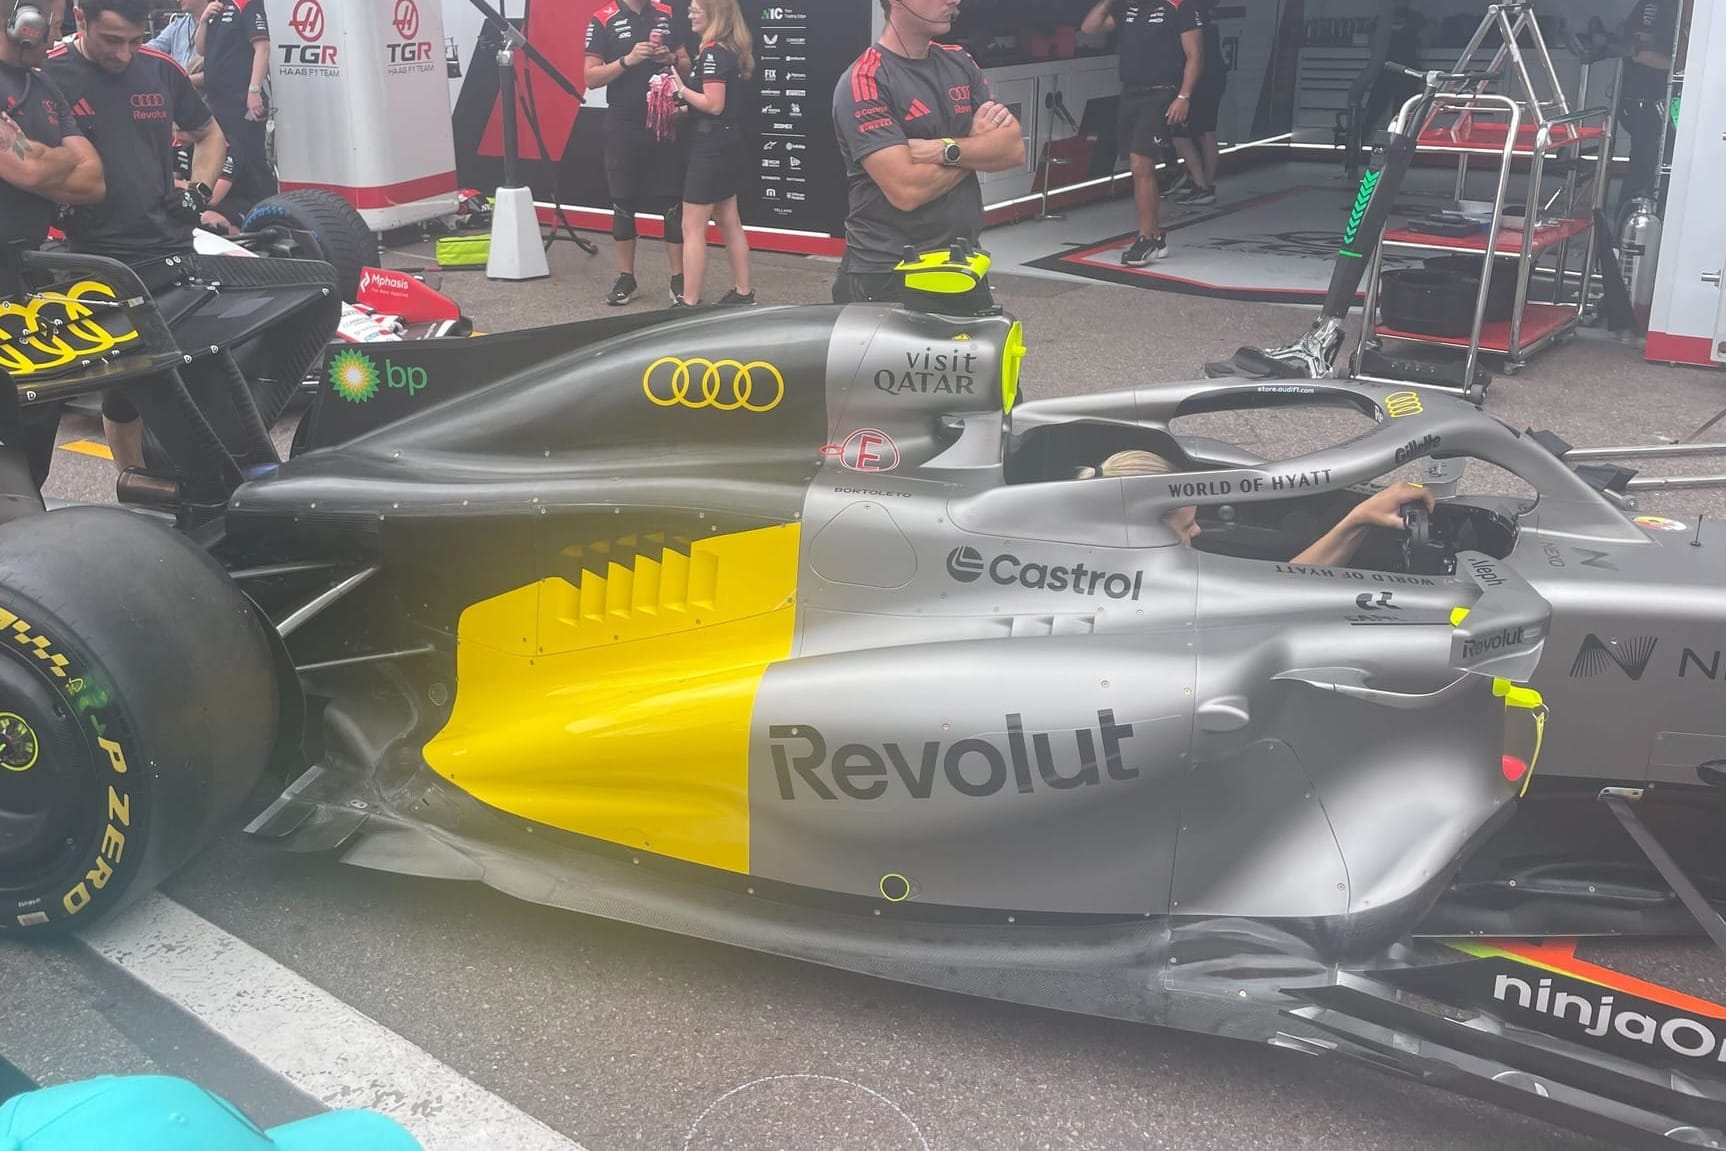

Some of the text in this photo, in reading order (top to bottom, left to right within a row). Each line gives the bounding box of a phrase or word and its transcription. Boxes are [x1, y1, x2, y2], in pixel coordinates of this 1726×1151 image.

[278, 45, 337, 64] TGR
[386, 42, 432, 63] TGR
[279, 67, 340, 78] HAAS F1 TEAM
[388, 66, 408, 74] HAAS
[416, 64, 434, 73] TEAM
[371, 273, 409, 290] Mphasis
[906, 346, 976, 374] visit
[385, 358, 428, 396] bp
[873, 369, 975, 396] QATAR
[834, 487, 913, 498] BORTOLETO
[1168, 469, 1333, 498] WORLD OF HYATT
[989, 553, 1144, 601] Castrol
[1274, 564, 1435, 586] WORLD OF HYATT
[1462, 626, 1522, 659] Revolut
[769, 708, 1139, 801] Revolut
[62, 736, 130, 915] P ZERO
[1493, 974, 1726, 1064] ninjaO
